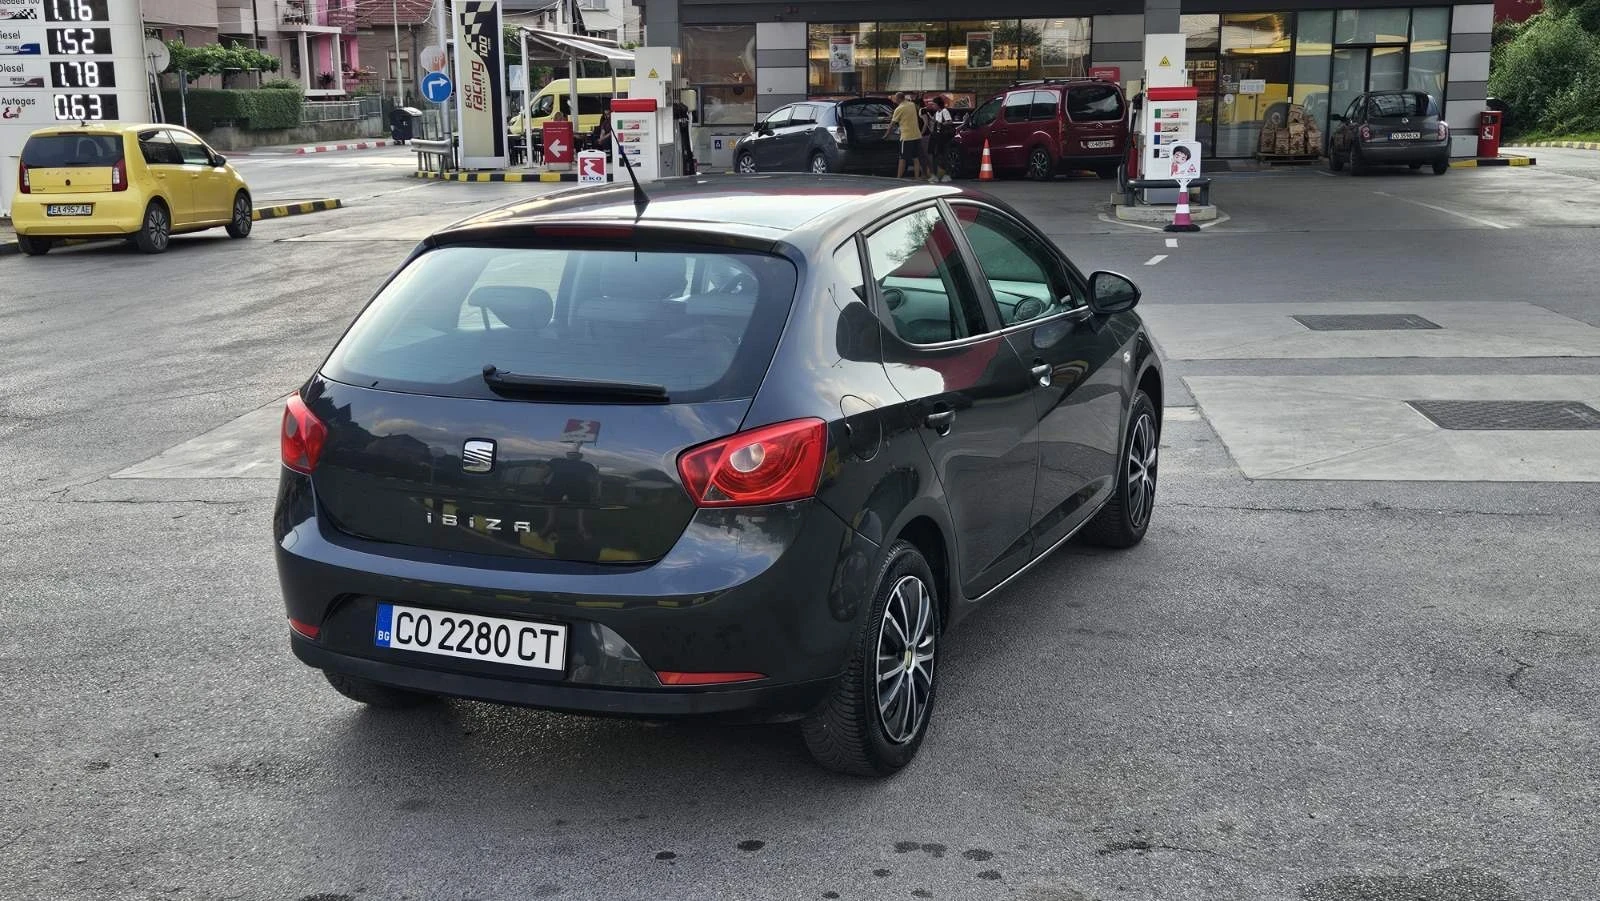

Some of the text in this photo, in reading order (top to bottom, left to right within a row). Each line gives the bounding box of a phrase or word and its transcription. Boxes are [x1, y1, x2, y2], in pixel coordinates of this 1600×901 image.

[57, 29, 95, 54] 1.52
[479, 34, 489, 57] 100
[60, 61, 99, 87] 1.78
[471, 60, 485, 111] racing
[2, 98, 36, 108] Autogas
[54, 94, 102, 120] 0.63
[52, 205, 61, 214] EA
[377, 611, 559, 664] BG CO 2280 CT
